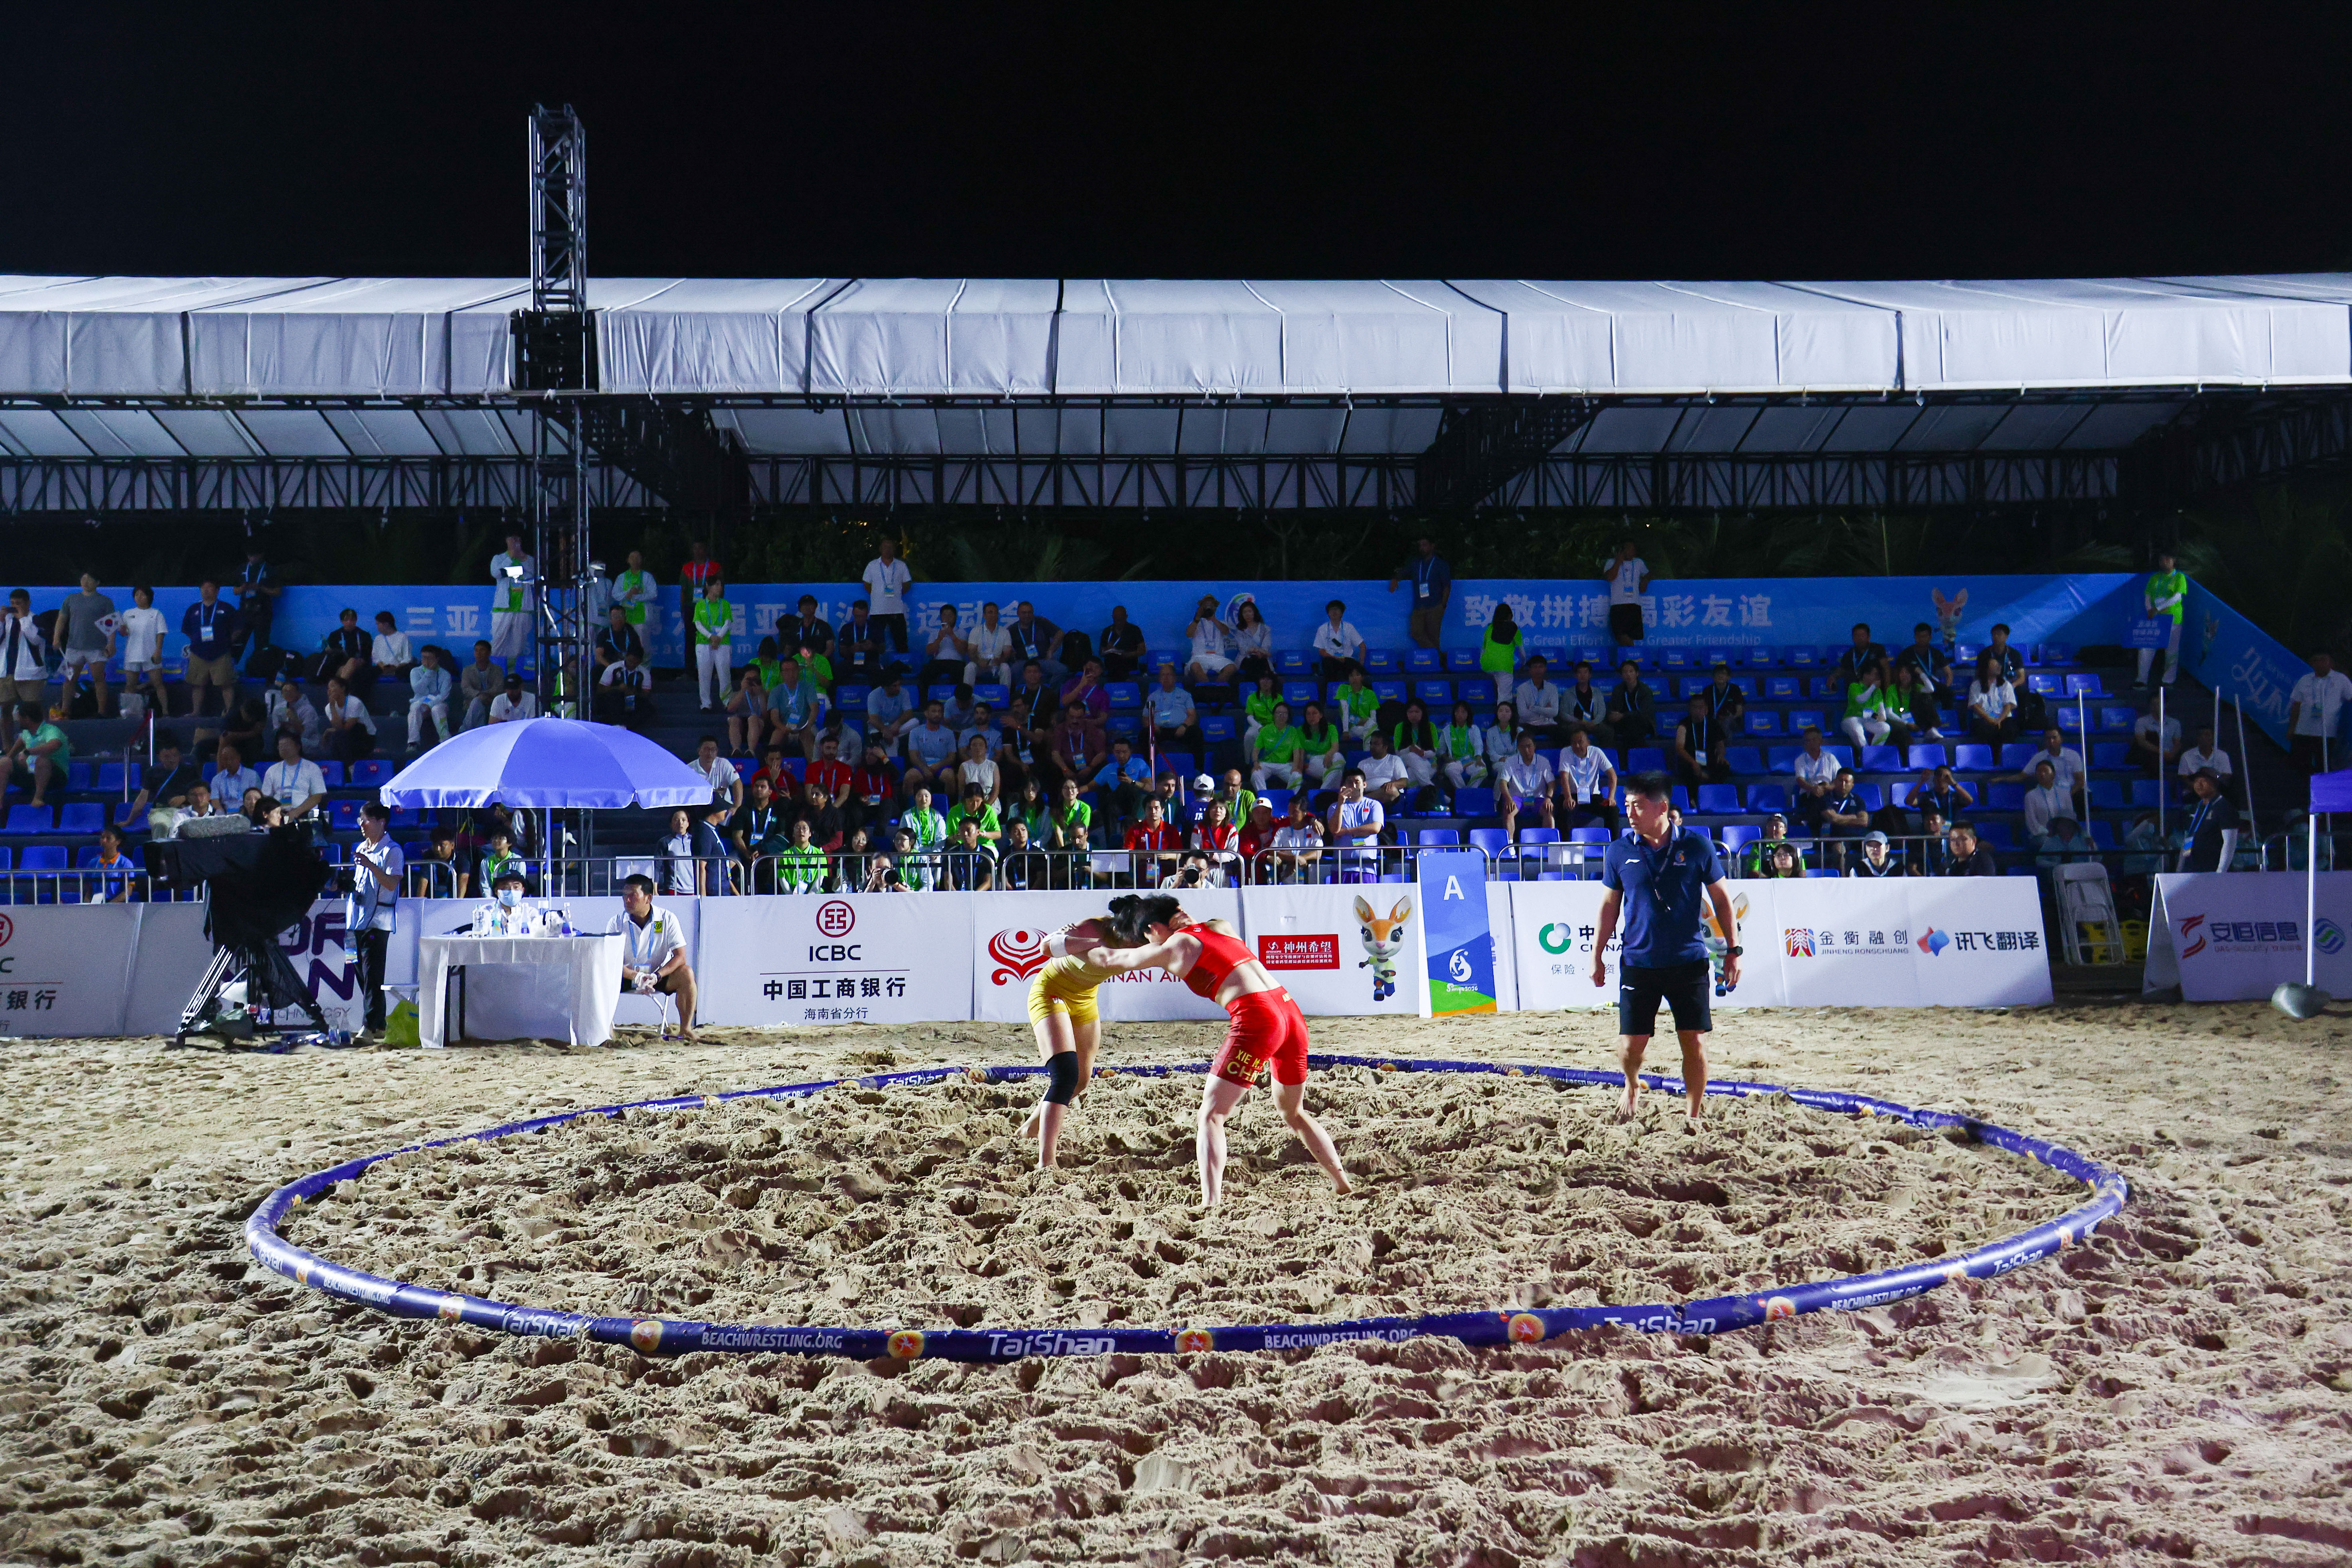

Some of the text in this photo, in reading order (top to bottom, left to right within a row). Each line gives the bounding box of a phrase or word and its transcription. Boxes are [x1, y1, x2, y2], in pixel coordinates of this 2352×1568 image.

[405, 605, 479, 637] 三亚
[1696, 635, 1761, 647] Friendship
[1444, 875, 1465, 900] A
[1819, 930, 1908, 945] 金衡融创
[1955, 931, 2039, 950] 讯飞翻译
[2210, 922, 2300, 941] 安恒信息
[809, 945, 861, 962] ICBC
[1284, 941, 1332, 953] 神州希望
[763, 977, 906, 1001] 中国工商银行
[804, 1007, 868, 1020] 海南省分行
[1235, 1049, 1252, 1064] XIE
[324, 1276, 391, 1305] BEACHWRESTLING.ORG
[1832, 1286, 1922, 1309] BEACHWRESTLINGORG
[701, 1332, 842, 1349] BEACHWRESTLING.ORG
[989, 1334, 1115, 1356] TaiShan
[1265, 1329, 1418, 1348] BEACHWRESTLINGORG
